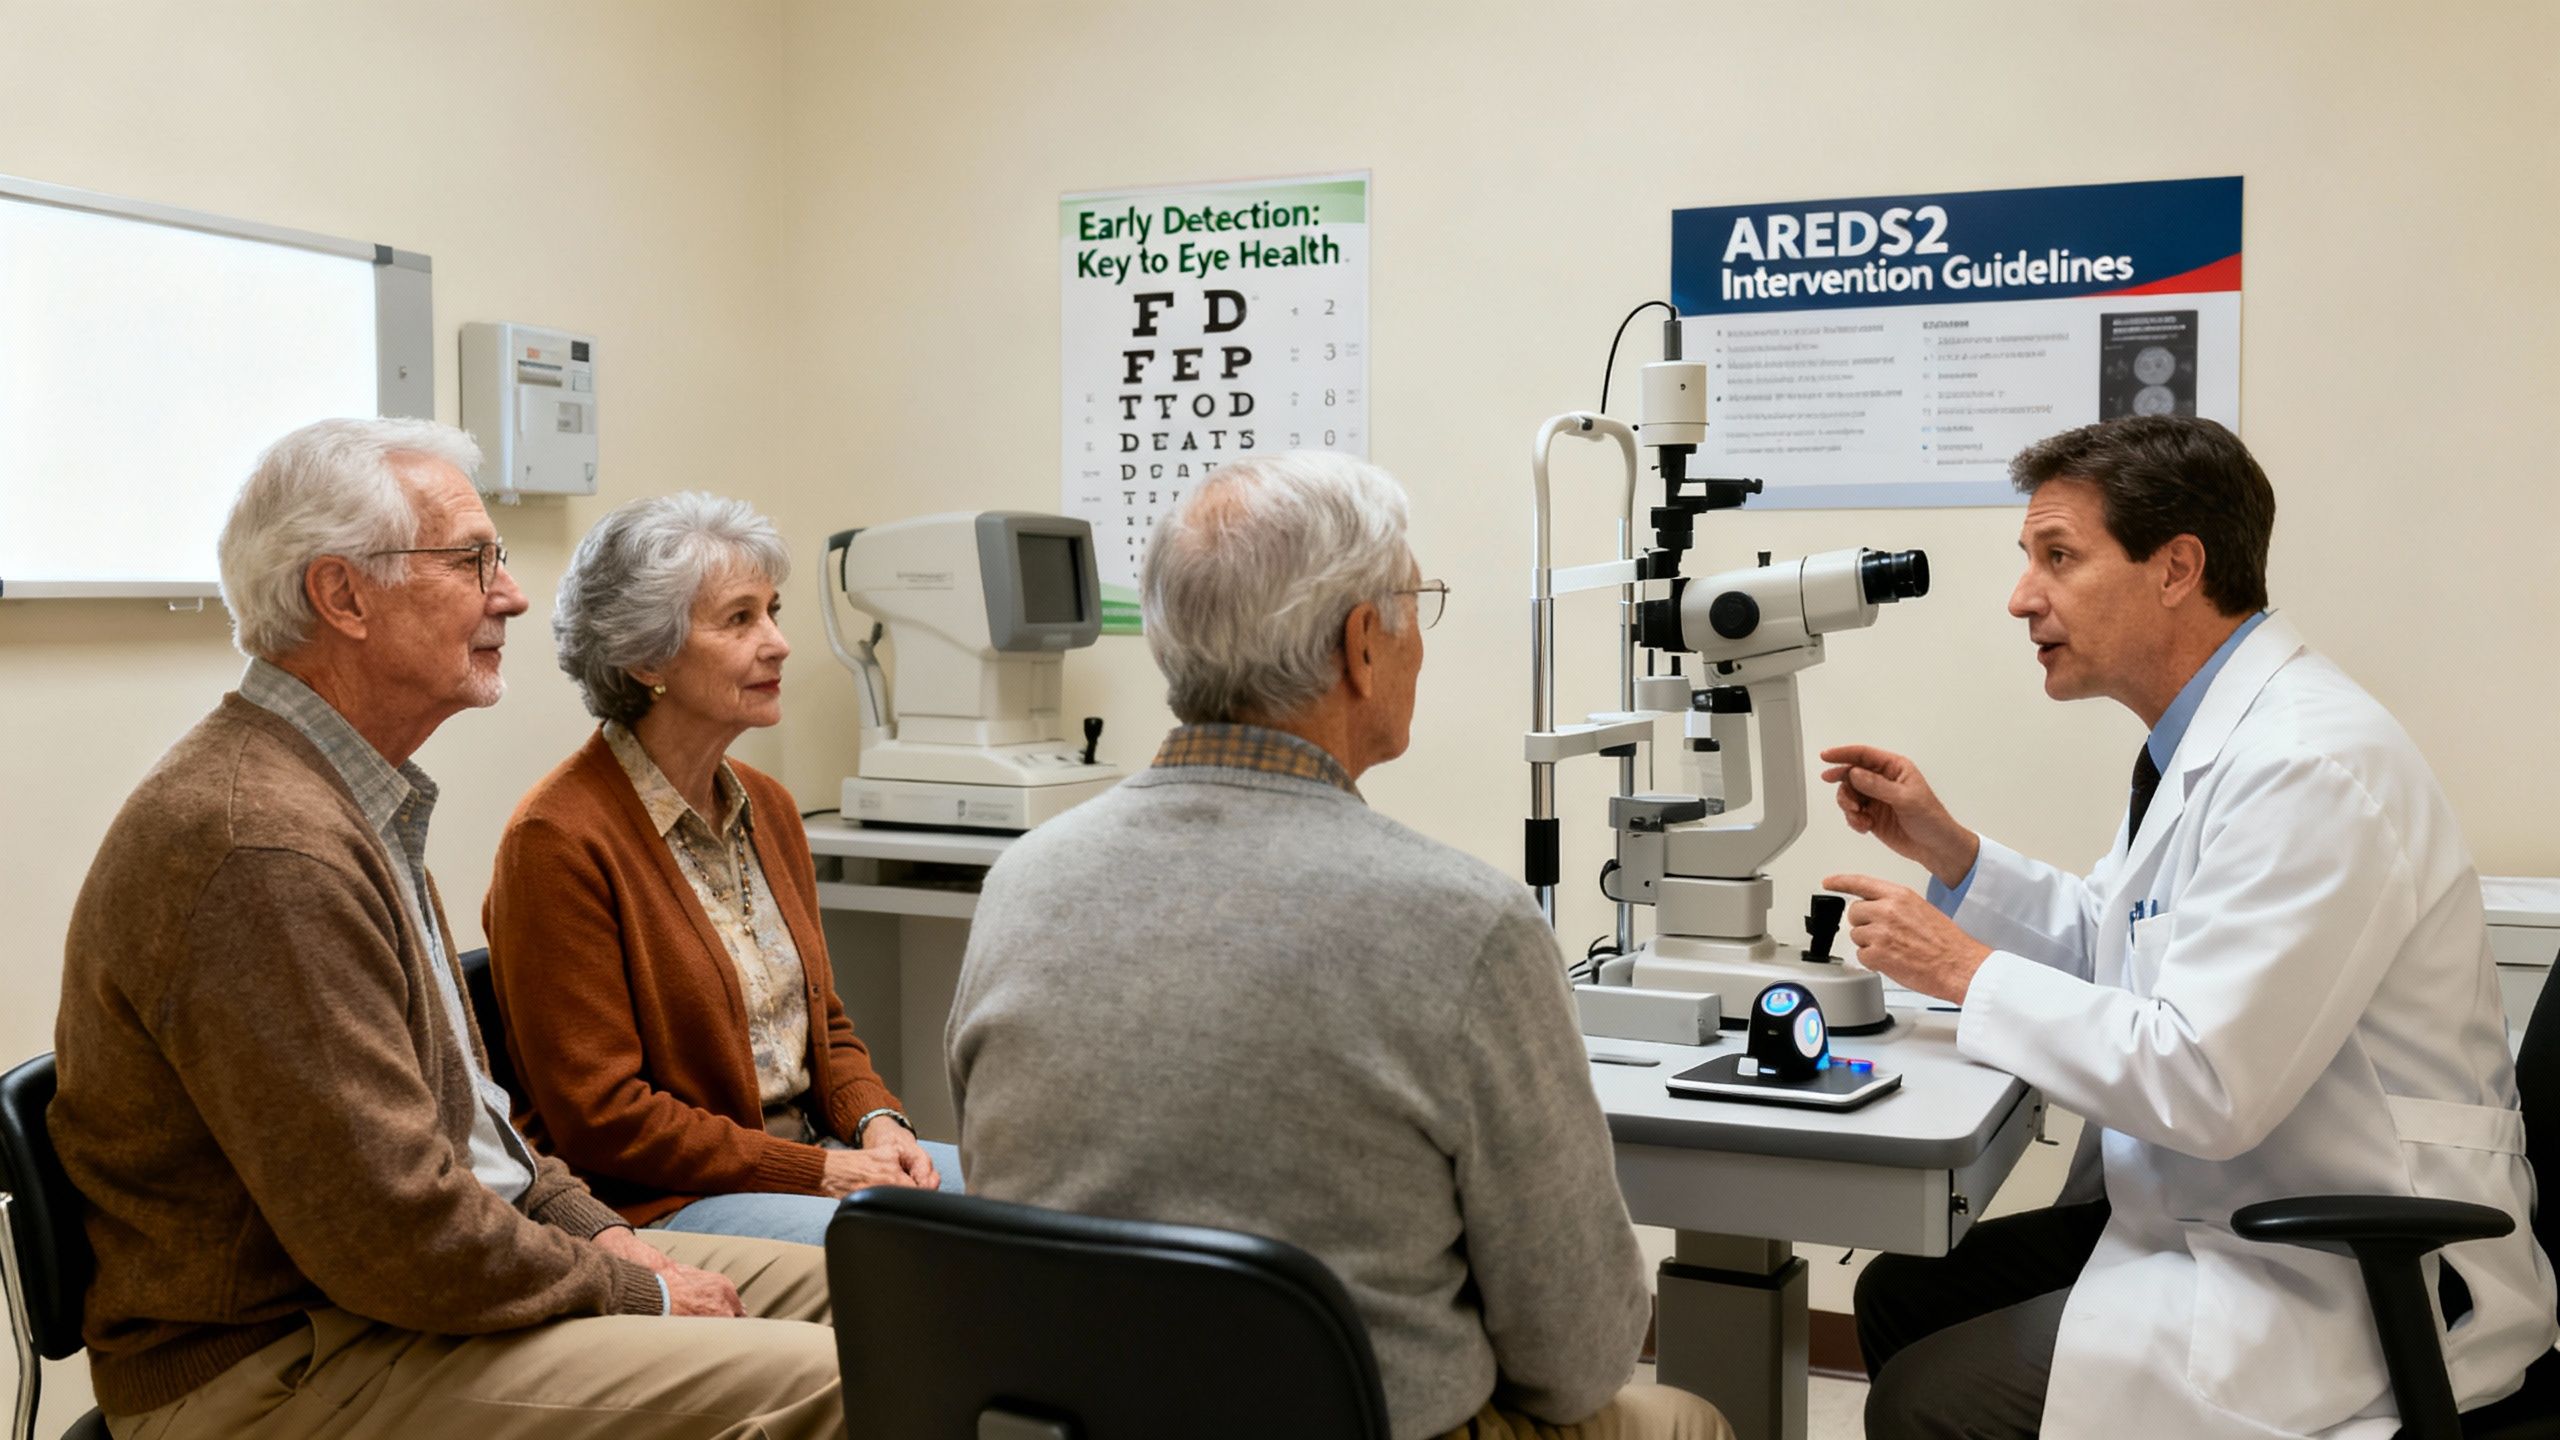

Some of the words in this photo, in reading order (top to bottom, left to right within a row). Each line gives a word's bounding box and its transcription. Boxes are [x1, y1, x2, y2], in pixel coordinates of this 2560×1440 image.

[1080, 206, 1152, 245] Early
[1163, 200, 1320, 235] Detection:
[1722, 205, 1949, 262] AREDS2
[1078, 249, 1132, 285] Key
[1139, 247, 1169, 274] to
[1179, 242, 1230, 279] Eye
[1240, 234, 1339, 269] Health
[1721, 258, 1934, 301] Intervention
[1942, 248, 2135, 290] Guidelines
[1132, 291, 1174, 338] F
[1203, 289, 1247, 334] D
